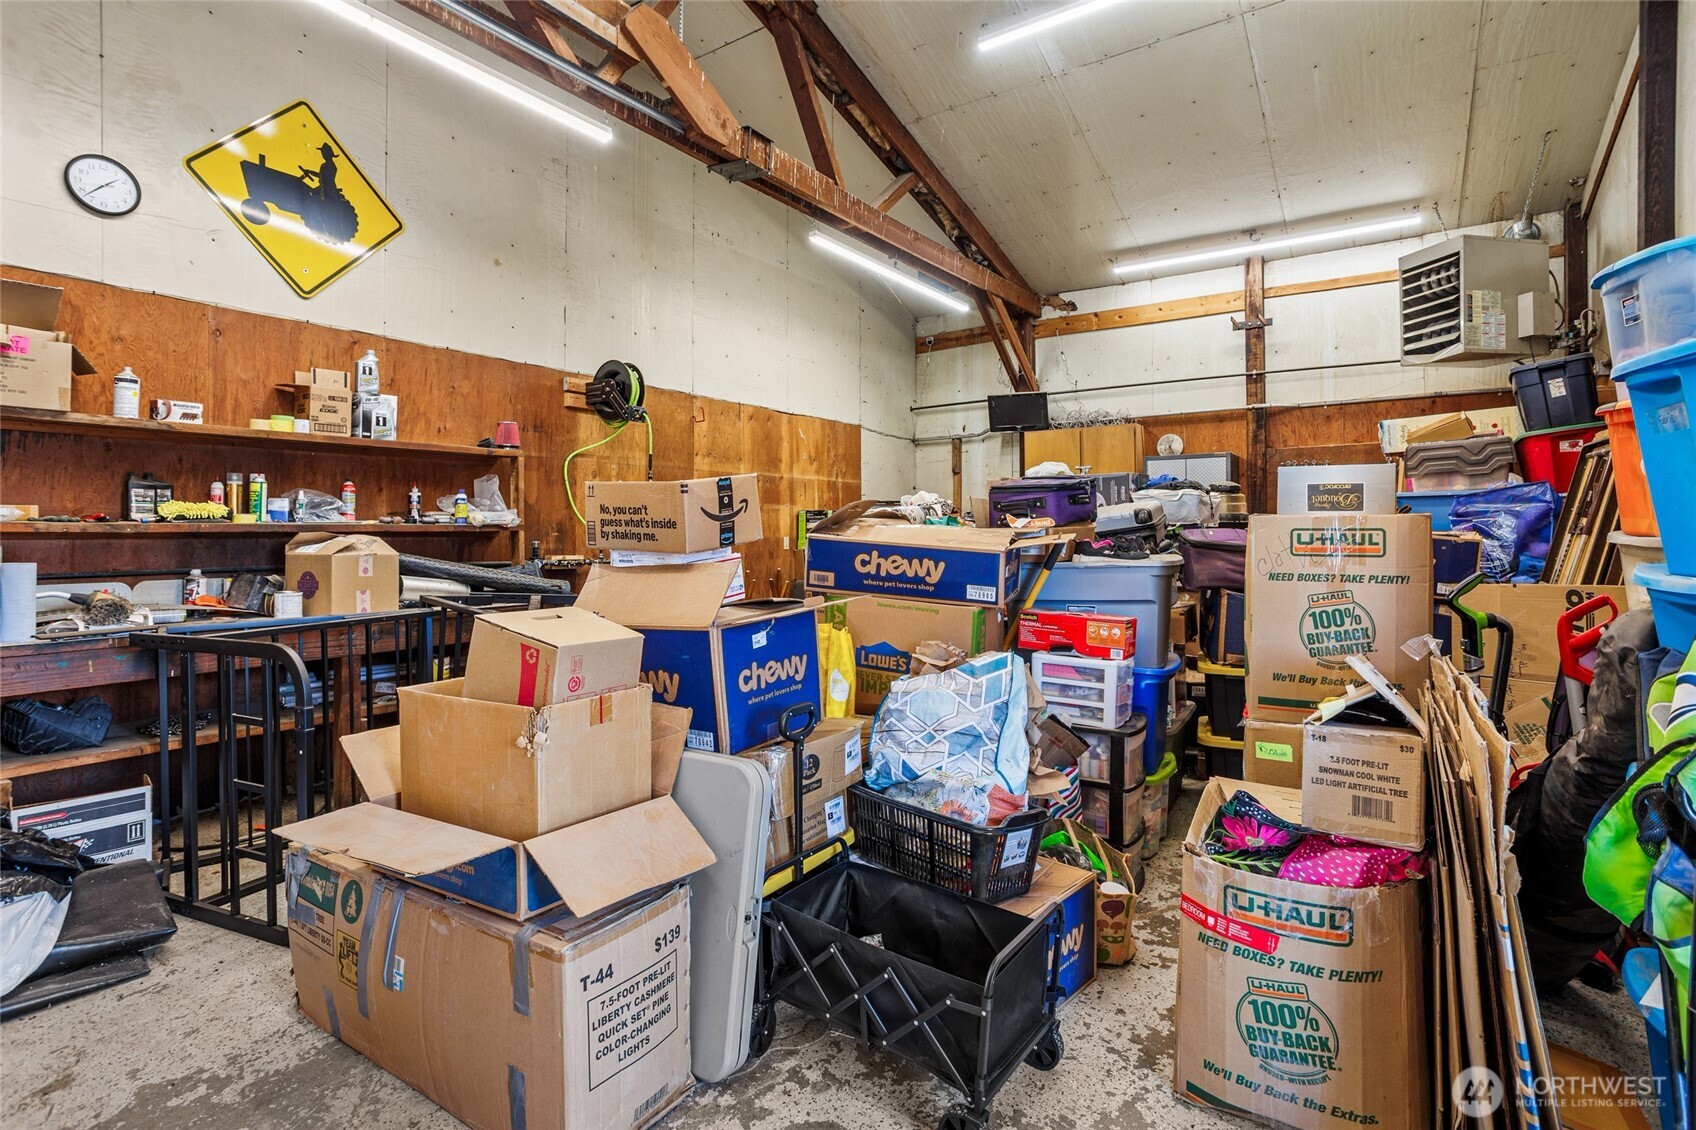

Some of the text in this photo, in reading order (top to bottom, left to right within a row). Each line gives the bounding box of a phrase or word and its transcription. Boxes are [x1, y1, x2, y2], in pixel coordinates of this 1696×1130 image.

[600, 504, 648, 516] No, you can't
[1310, 492, 1362, 510] Bouquet
[600, 516, 677, 530] guess what's inside
[601, 529, 658, 543] by shaking me.
[1296, 532, 1379, 546] U-HAUL
[854, 550, 946, 584] chewy
[863, 578, 935, 592] where pet lovers shop
[1268, 572, 1410, 585] NEED BOXES? TAKE PLENTY!
[974, 592, 994, 600] 76985
[1310, 592, 1351, 603] U-HAUL
[877, 602, 940, 615] lowes.com/moving
[1308, 606, 1362, 630] 100%
[1306, 627, 1370, 646] BUY-BACK
[861, 650, 907, 671] LOWE'S
[738, 654, 808, 693] chewy
[1272, 672, 1297, 682] We'll
[1299, 674, 1318, 686] Buy
[1320, 676, 1346, 687] Back
[748, 683, 802, 705] where pet lovers shop
[1311, 734, 1327, 742] T-18
[1400, 744, 1414, 754] $30
[805, 758, 814, 769] 12
[1342, 758, 1361, 767] FOOT
[1362, 760, 1389, 770] PRE-LIT
[1318, 766, 1400, 785] SNOWMAN COOL WHITE
[1311, 777, 1408, 798] LED LIGHT ARTIFICIAL TREE
[94, 849, 134, 864] ENTIONAL
[1182, 900, 1206, 920] BEDROOM
[1232, 892, 1350, 931] U-HAUL
[654, 924, 681, 954] $139
[1198, 932, 1383, 984] NEED BOXES? TAKE PLENTY!
[580, 962, 614, 992] T-44
[600, 961, 672, 1012] 7.5-FOOT PRE-LIT
[1250, 980, 1304, 995] U-HAUL
[592, 972, 675, 1032] LIBERTY CASHMERE
[598, 1020, 628, 1044] QUICK
[652, 991, 670, 1011] PINE
[1248, 998, 1320, 1032] 100%
[595, 1004, 672, 1061] COLOR-CHANGING
[1245, 1024, 1333, 1054] BUY-BACK
[618, 1034, 650, 1062] LIGHTS
[1203, 1059, 1379, 1125] We'll Buy Back the Extras.
